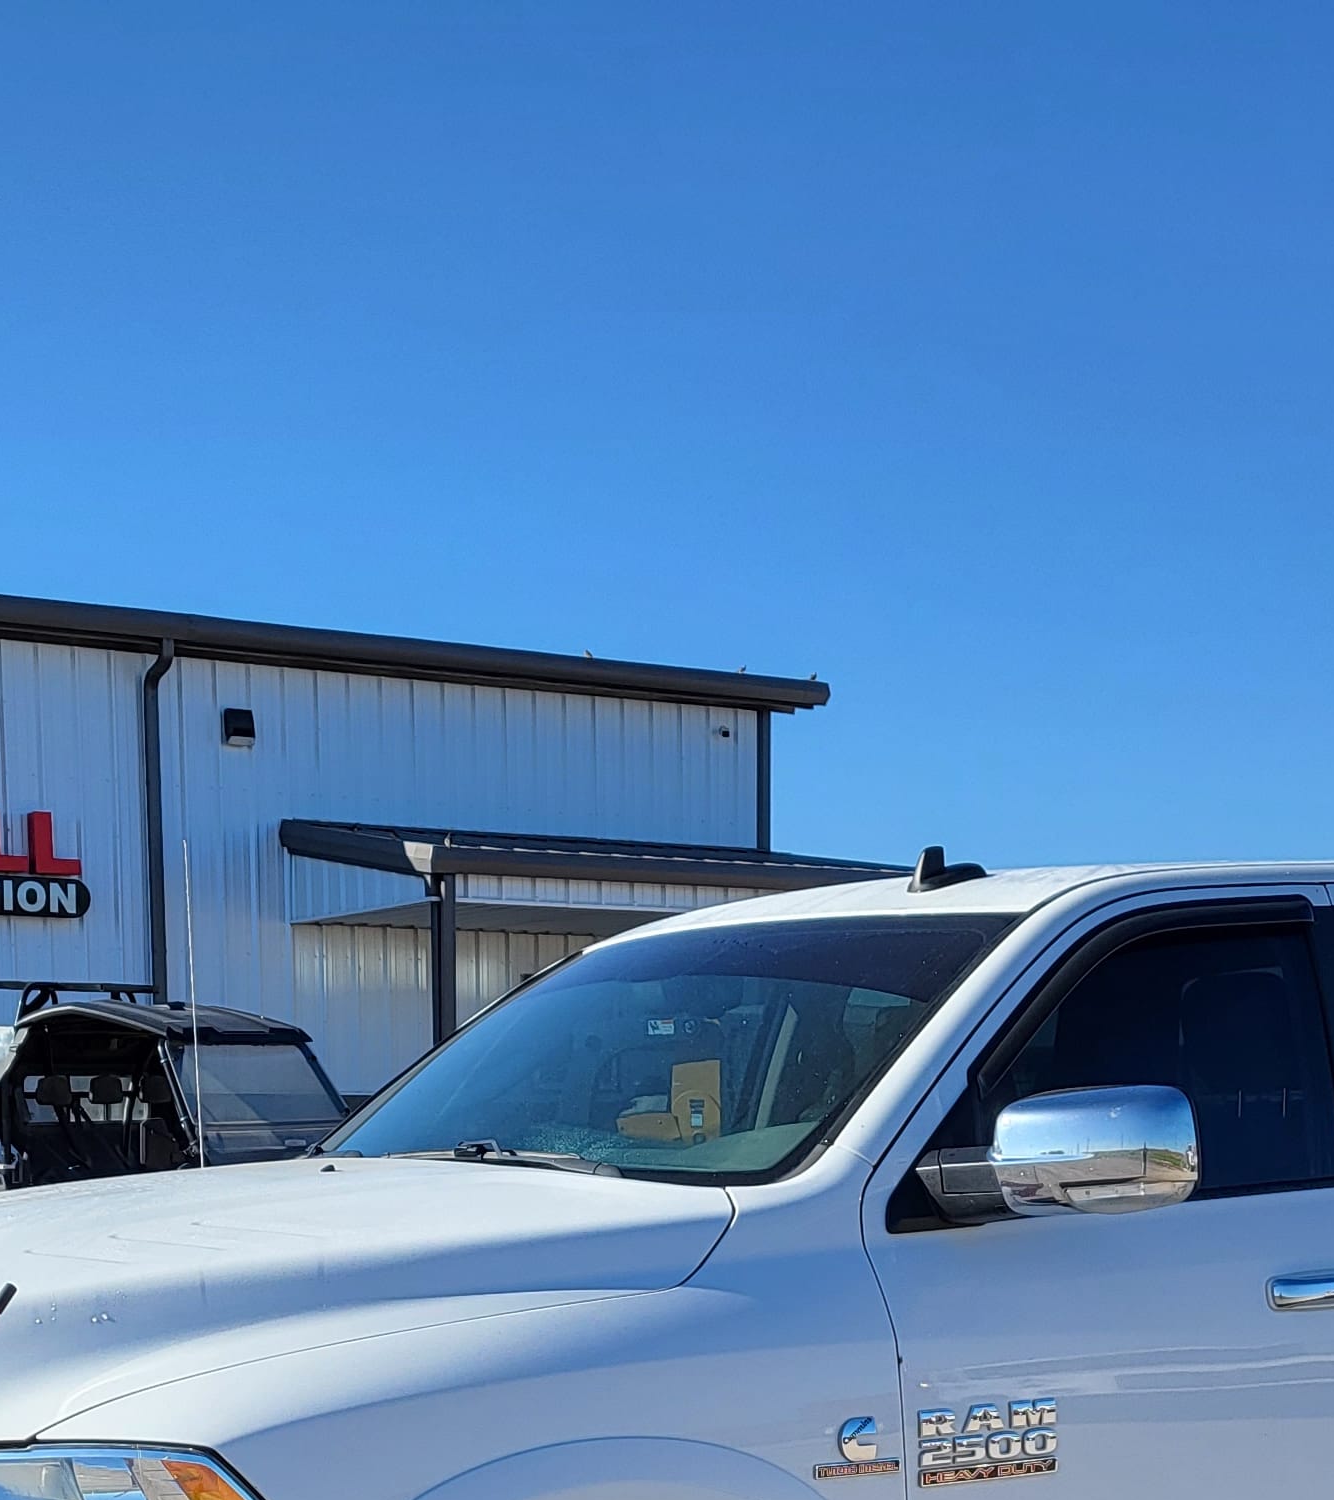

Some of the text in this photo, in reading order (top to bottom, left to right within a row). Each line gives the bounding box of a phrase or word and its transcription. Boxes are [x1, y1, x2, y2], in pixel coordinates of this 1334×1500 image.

[917, 1397, 1057, 1438] RAM
[918, 1426, 1058, 1468] 2500
[925, 1459, 1053, 1484] HEAVY DUTY
